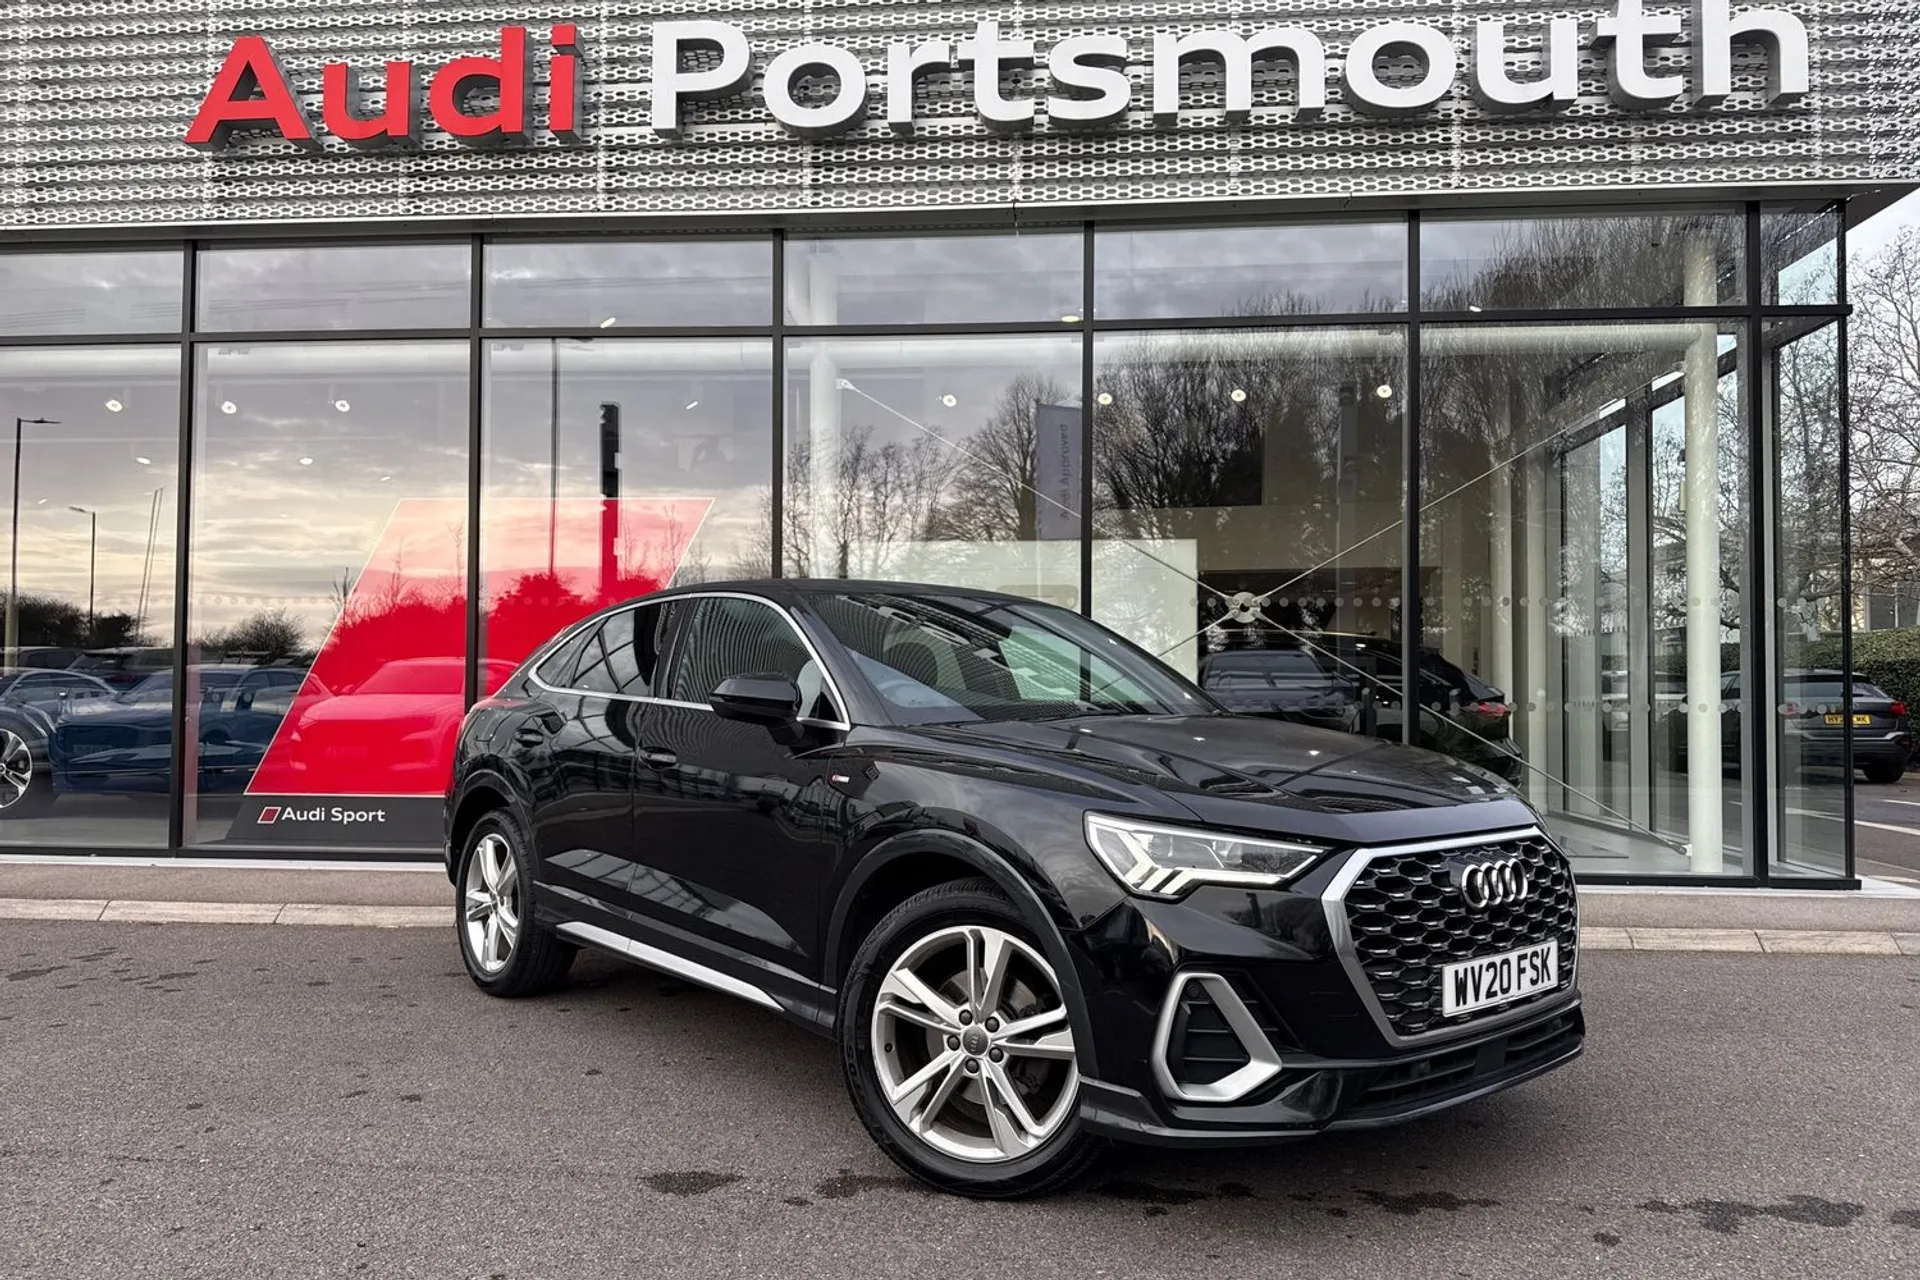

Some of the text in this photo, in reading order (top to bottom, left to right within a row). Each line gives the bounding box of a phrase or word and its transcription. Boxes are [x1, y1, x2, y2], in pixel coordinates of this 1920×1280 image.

[184, 0, 1810, 147] Audi Portsmouth
[1059, 423, 1073, 485] Approved
[281, 807, 386, 825] Audi Sport
[1454, 946, 1552, 1007] WV20 FSK
